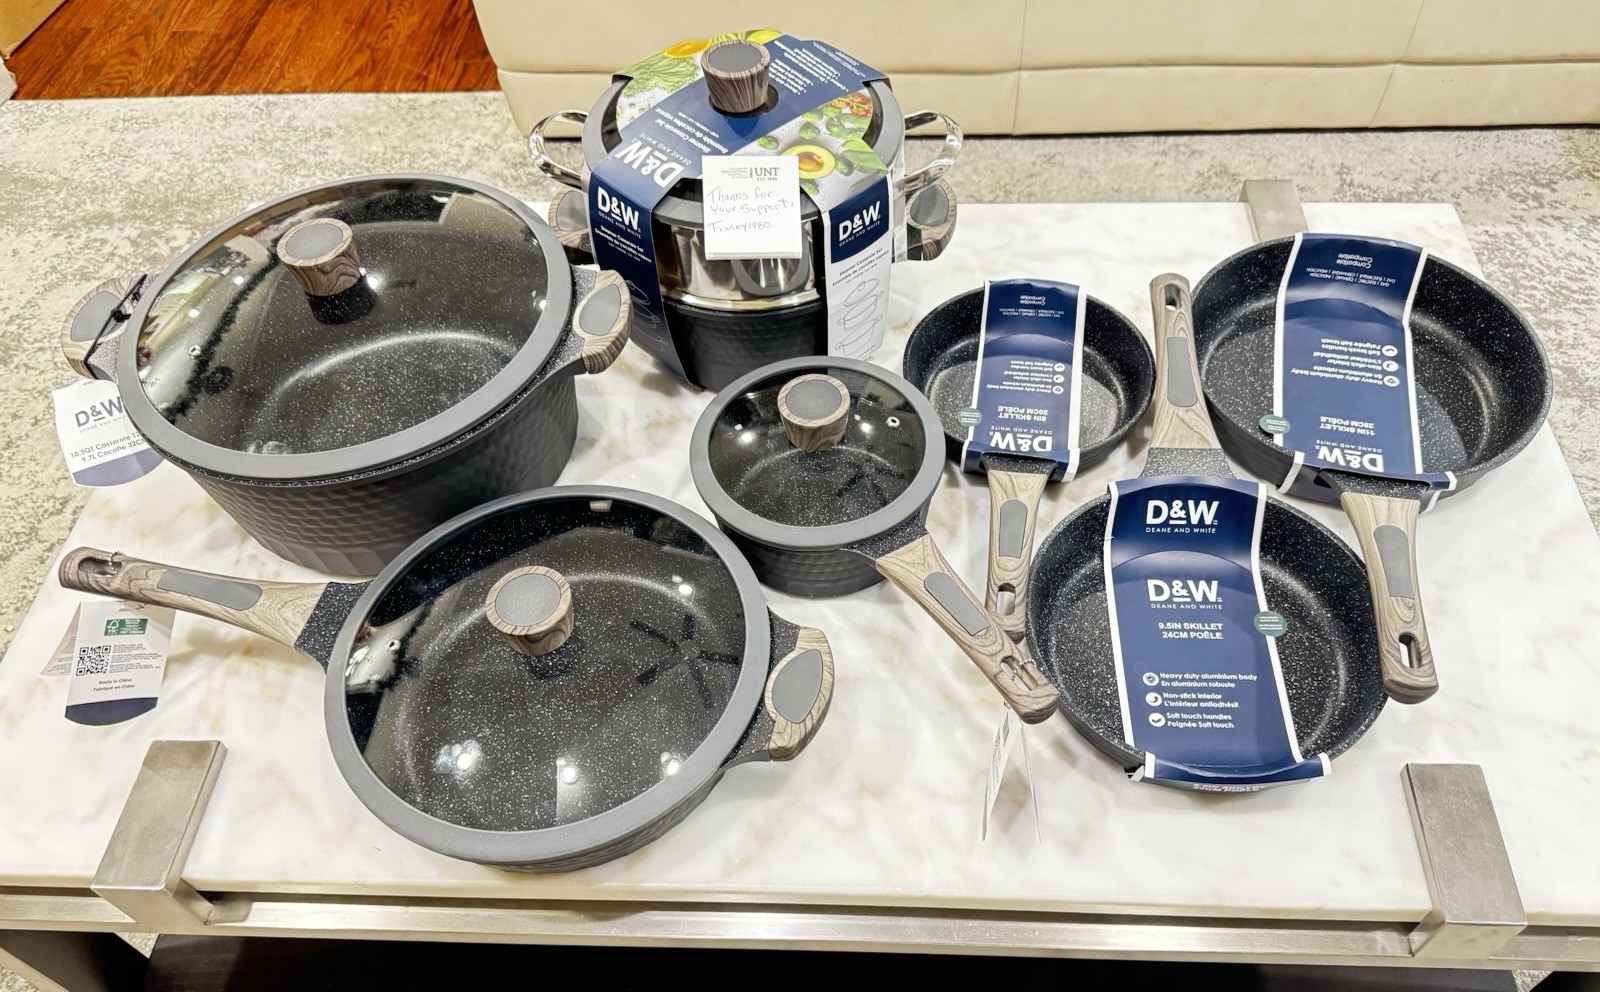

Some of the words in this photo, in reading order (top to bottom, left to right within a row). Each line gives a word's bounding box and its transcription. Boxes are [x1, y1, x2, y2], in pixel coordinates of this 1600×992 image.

[640, 132, 658, 145] WHITE
[658, 143, 671, 154] AND
[615, 141, 685, 188] D&W
[670, 151, 692, 165] DEANE
[754, 167, 779, 176] UNT
[707, 186, 748, 203] Thanks
[755, 186, 772, 199] for
[597, 186, 639, 231] D&W
[839, 201, 880, 241] D&W
[1336, 259, 1371, 268] Compatible
[1338, 252, 1373, 262] Compatible
[75, 396, 123, 427] D&W
[998, 406, 1024, 414] POÊLE
[999, 413, 1032, 421] SKILLET
[1320, 416, 1348, 427] POÊLE
[80, 425, 97, 433] DEANE
[1320, 423, 1355, 433] SKILLET
[1357, 426, 1375, 435] 11IN
[71, 446, 94, 458] 10.3QT
[96, 435, 130, 450] Casserole
[990, 432, 1052, 451] D&W
[82, 454, 96, 462] 9.7L
[98, 446, 126, 457] Cocotte
[1357, 445, 1381, 453] DEANE
[1318, 447, 1384, 472] D&W
[1146, 500, 1219, 525] D&W
[1147, 580, 1218, 602] D&W
[1191, 631, 1223, 639] POÊLE
